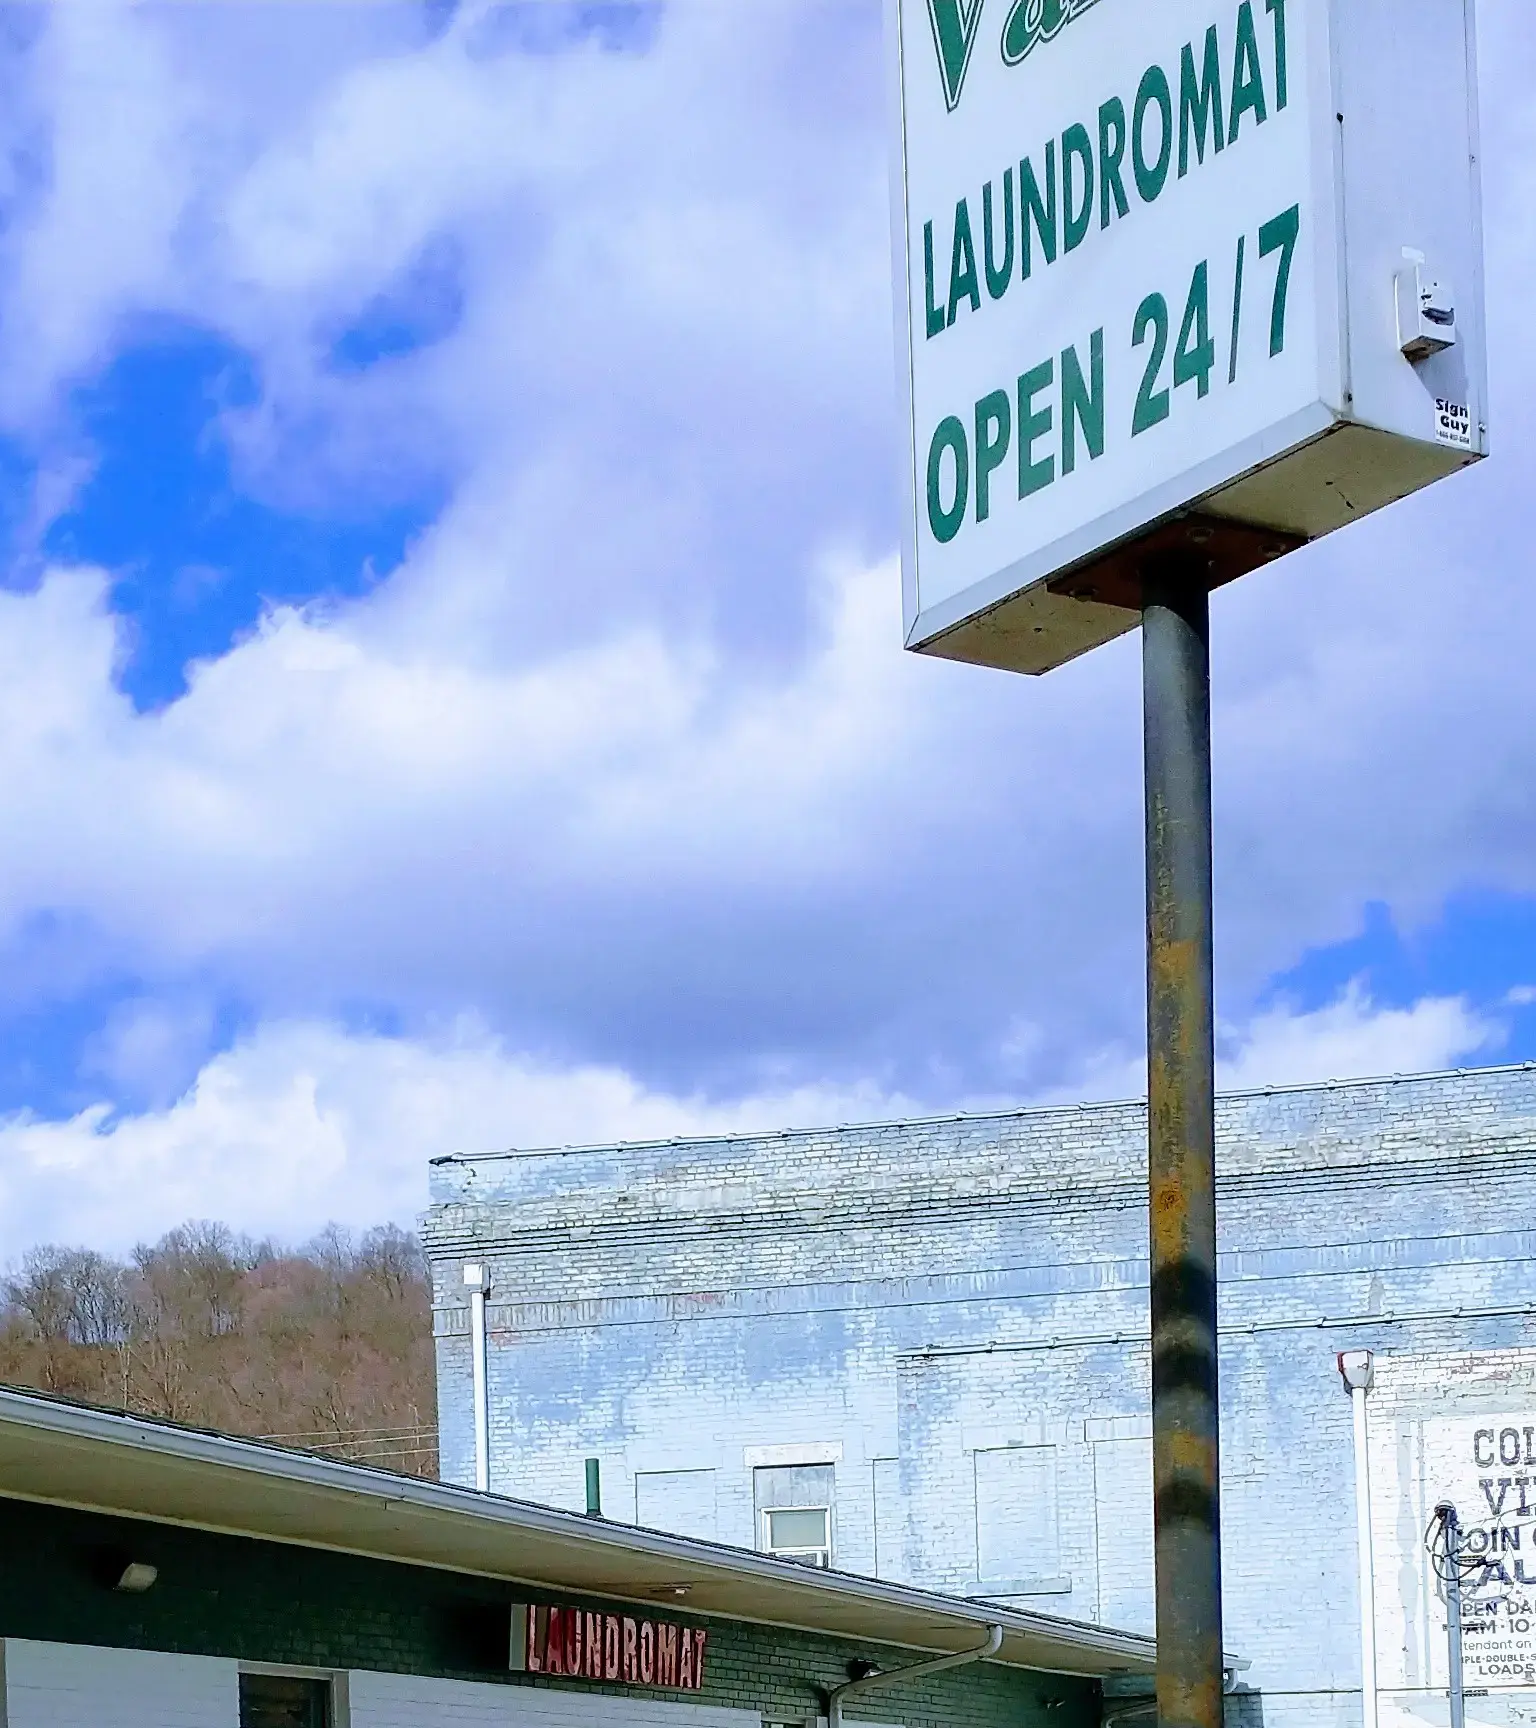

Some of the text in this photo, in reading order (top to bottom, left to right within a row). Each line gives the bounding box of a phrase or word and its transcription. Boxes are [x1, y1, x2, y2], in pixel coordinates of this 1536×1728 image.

[923, 0, 1288, 340] LAUNDROMAT
[927, 203, 1300, 544] OPEN 24/7
[1435, 398, 1468, 418] Sign
[1440, 415, 1469, 435] Guy
[1460, 1525, 1521, 1554] OIN
[1462, 1601, 1498, 1617] PEN
[528, 1603, 707, 1690] LAUNDROMAT
[1515, 1640, 1532, 1649] on
[1478, 1663, 1536, 1676] LOADS
